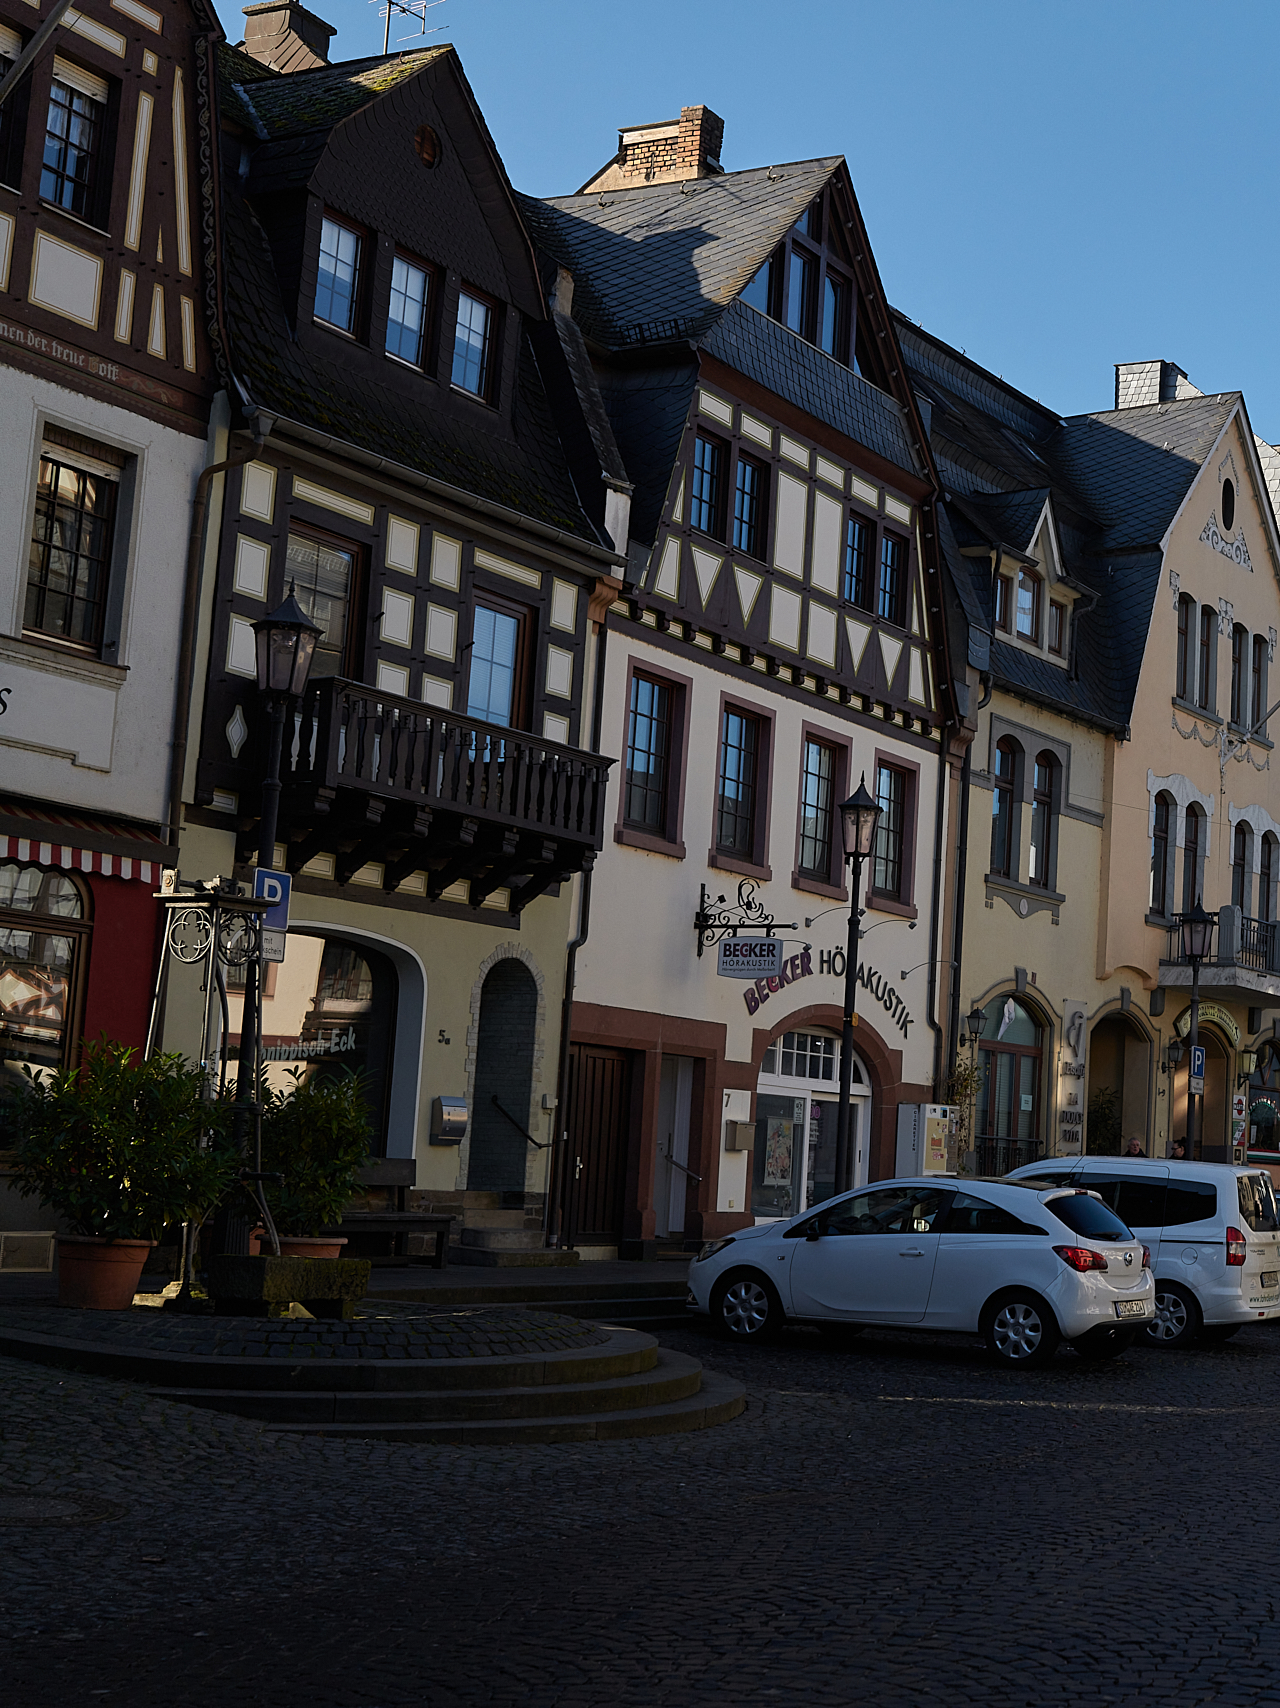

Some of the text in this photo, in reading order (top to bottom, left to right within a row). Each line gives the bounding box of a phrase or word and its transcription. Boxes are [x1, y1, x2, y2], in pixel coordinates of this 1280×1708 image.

[263, 877, 282, 918] P
[723, 943, 776, 958] BECKER
[722, 958, 776, 967] HÖRAKUSTIK
[743, 945, 914, 1039] BECKER HÖAKUSTIK
[438, 1029, 451, 1045] 5a
[1194, 1050, 1203, 1073] P
[725, 1093, 731, 1107] 7
